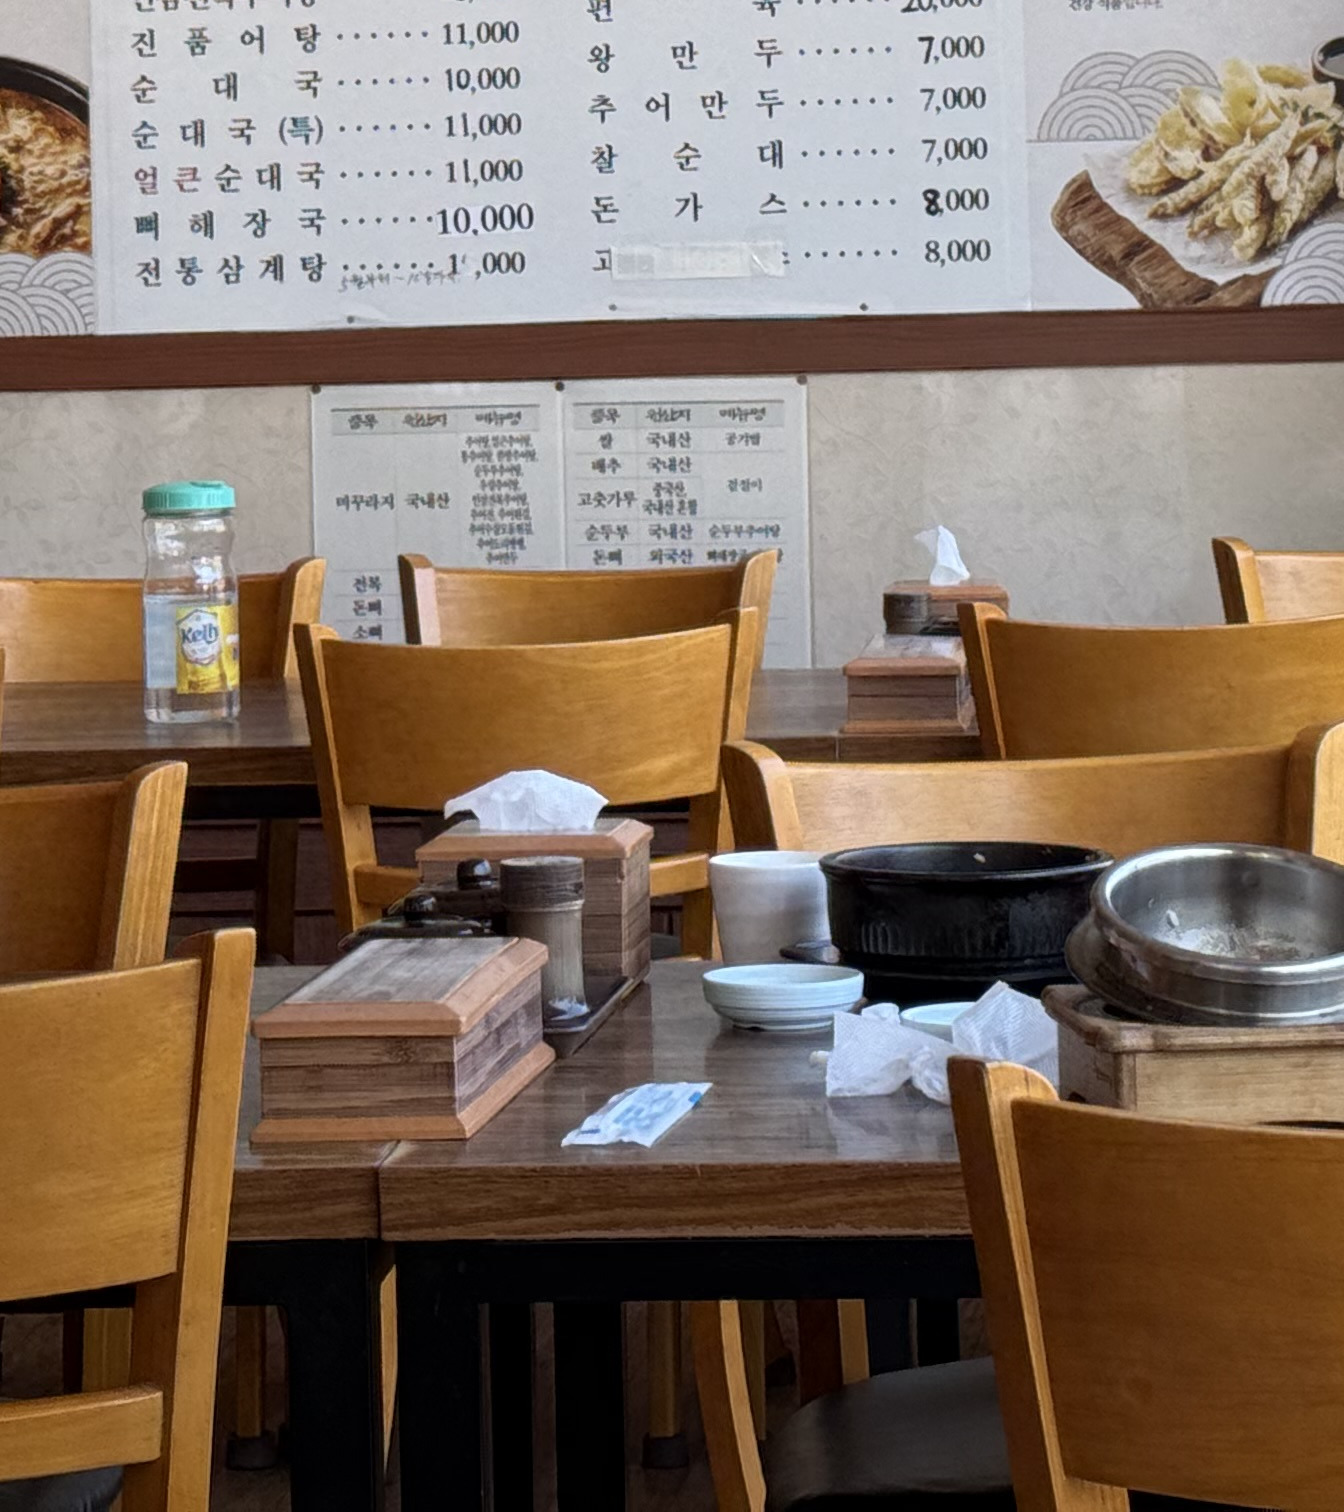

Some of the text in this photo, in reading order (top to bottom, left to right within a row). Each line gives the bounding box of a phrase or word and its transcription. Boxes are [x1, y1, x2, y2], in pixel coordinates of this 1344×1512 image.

[442, 20, 520, 49] 11,000
[917, 35, 986, 65] 7,000
[444, 65, 522, 96] 10,000
[919, 86, 987, 114] 7,000
[445, 112, 523, 141] 11,000
[921, 137, 988, 167] 7,000
[445, 158, 524, 187] 11,000
[922, 187, 990, 217] 8,000
[448, 250, 526, 280] 1,000
[924, 239, 991, 267] 8,000
[646, 431, 692, 449] 국내산
[647, 456, 692, 473] 국내산
[335, 491, 450, 511] 미꾸라지 국내산
[577, 490, 638, 508] 고춧가루
[585, 524, 629, 541] 순두부
[648, 523, 693, 540] 국내산
